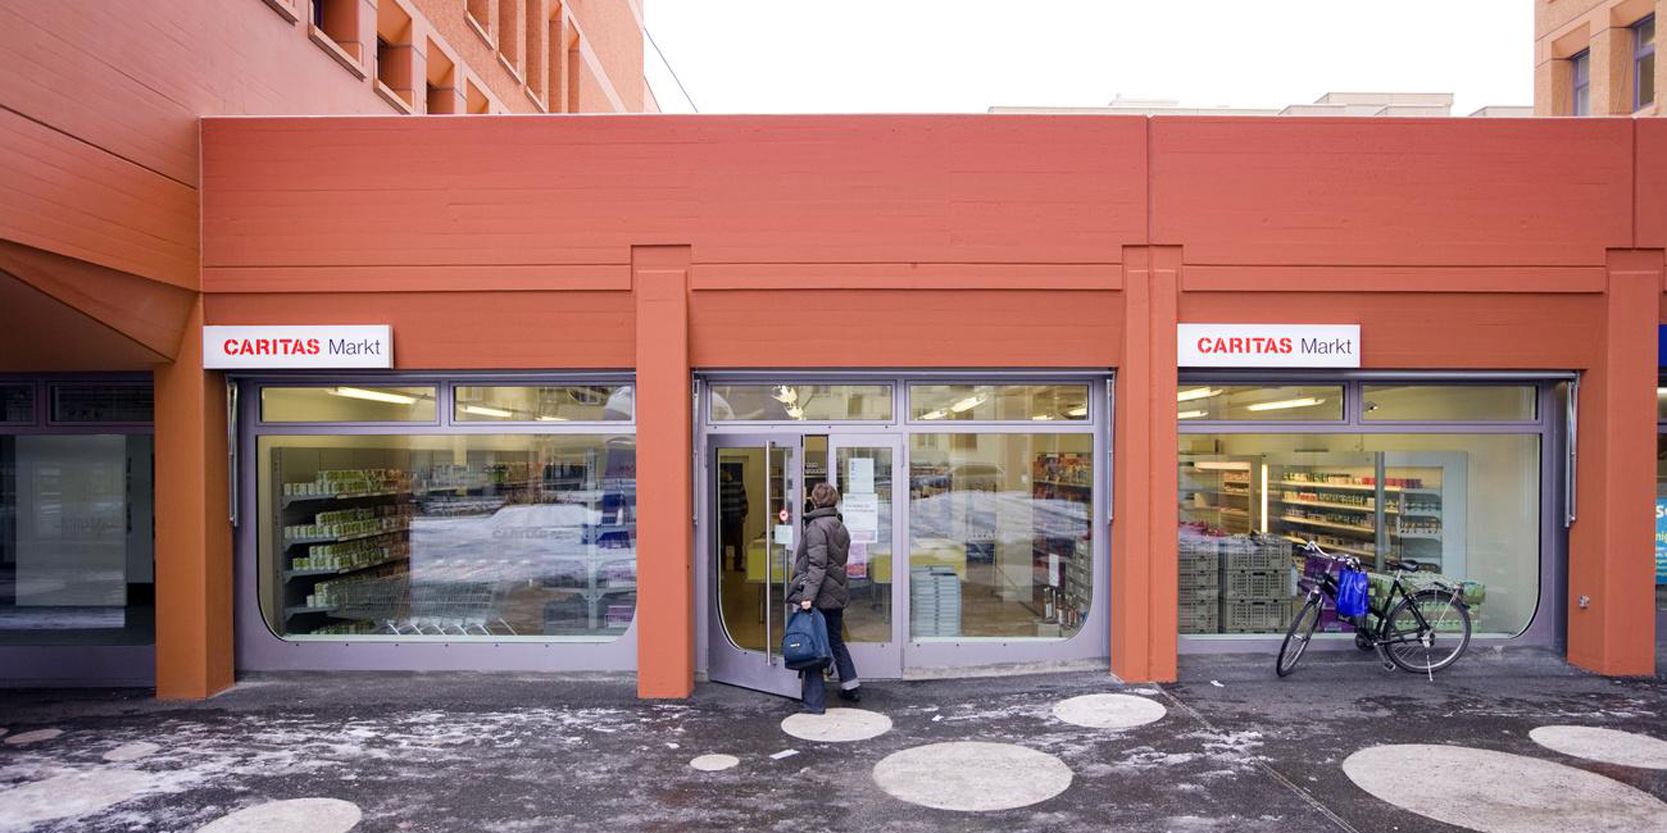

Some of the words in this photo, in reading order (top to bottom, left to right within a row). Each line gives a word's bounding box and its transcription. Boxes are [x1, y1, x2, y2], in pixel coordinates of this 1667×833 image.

[223, 338, 320, 355] CARITAS
[328, 338, 381, 355] Markt
[1197, 337, 1293, 354] CARITAS
[1300, 337, 1352, 354] Markt
